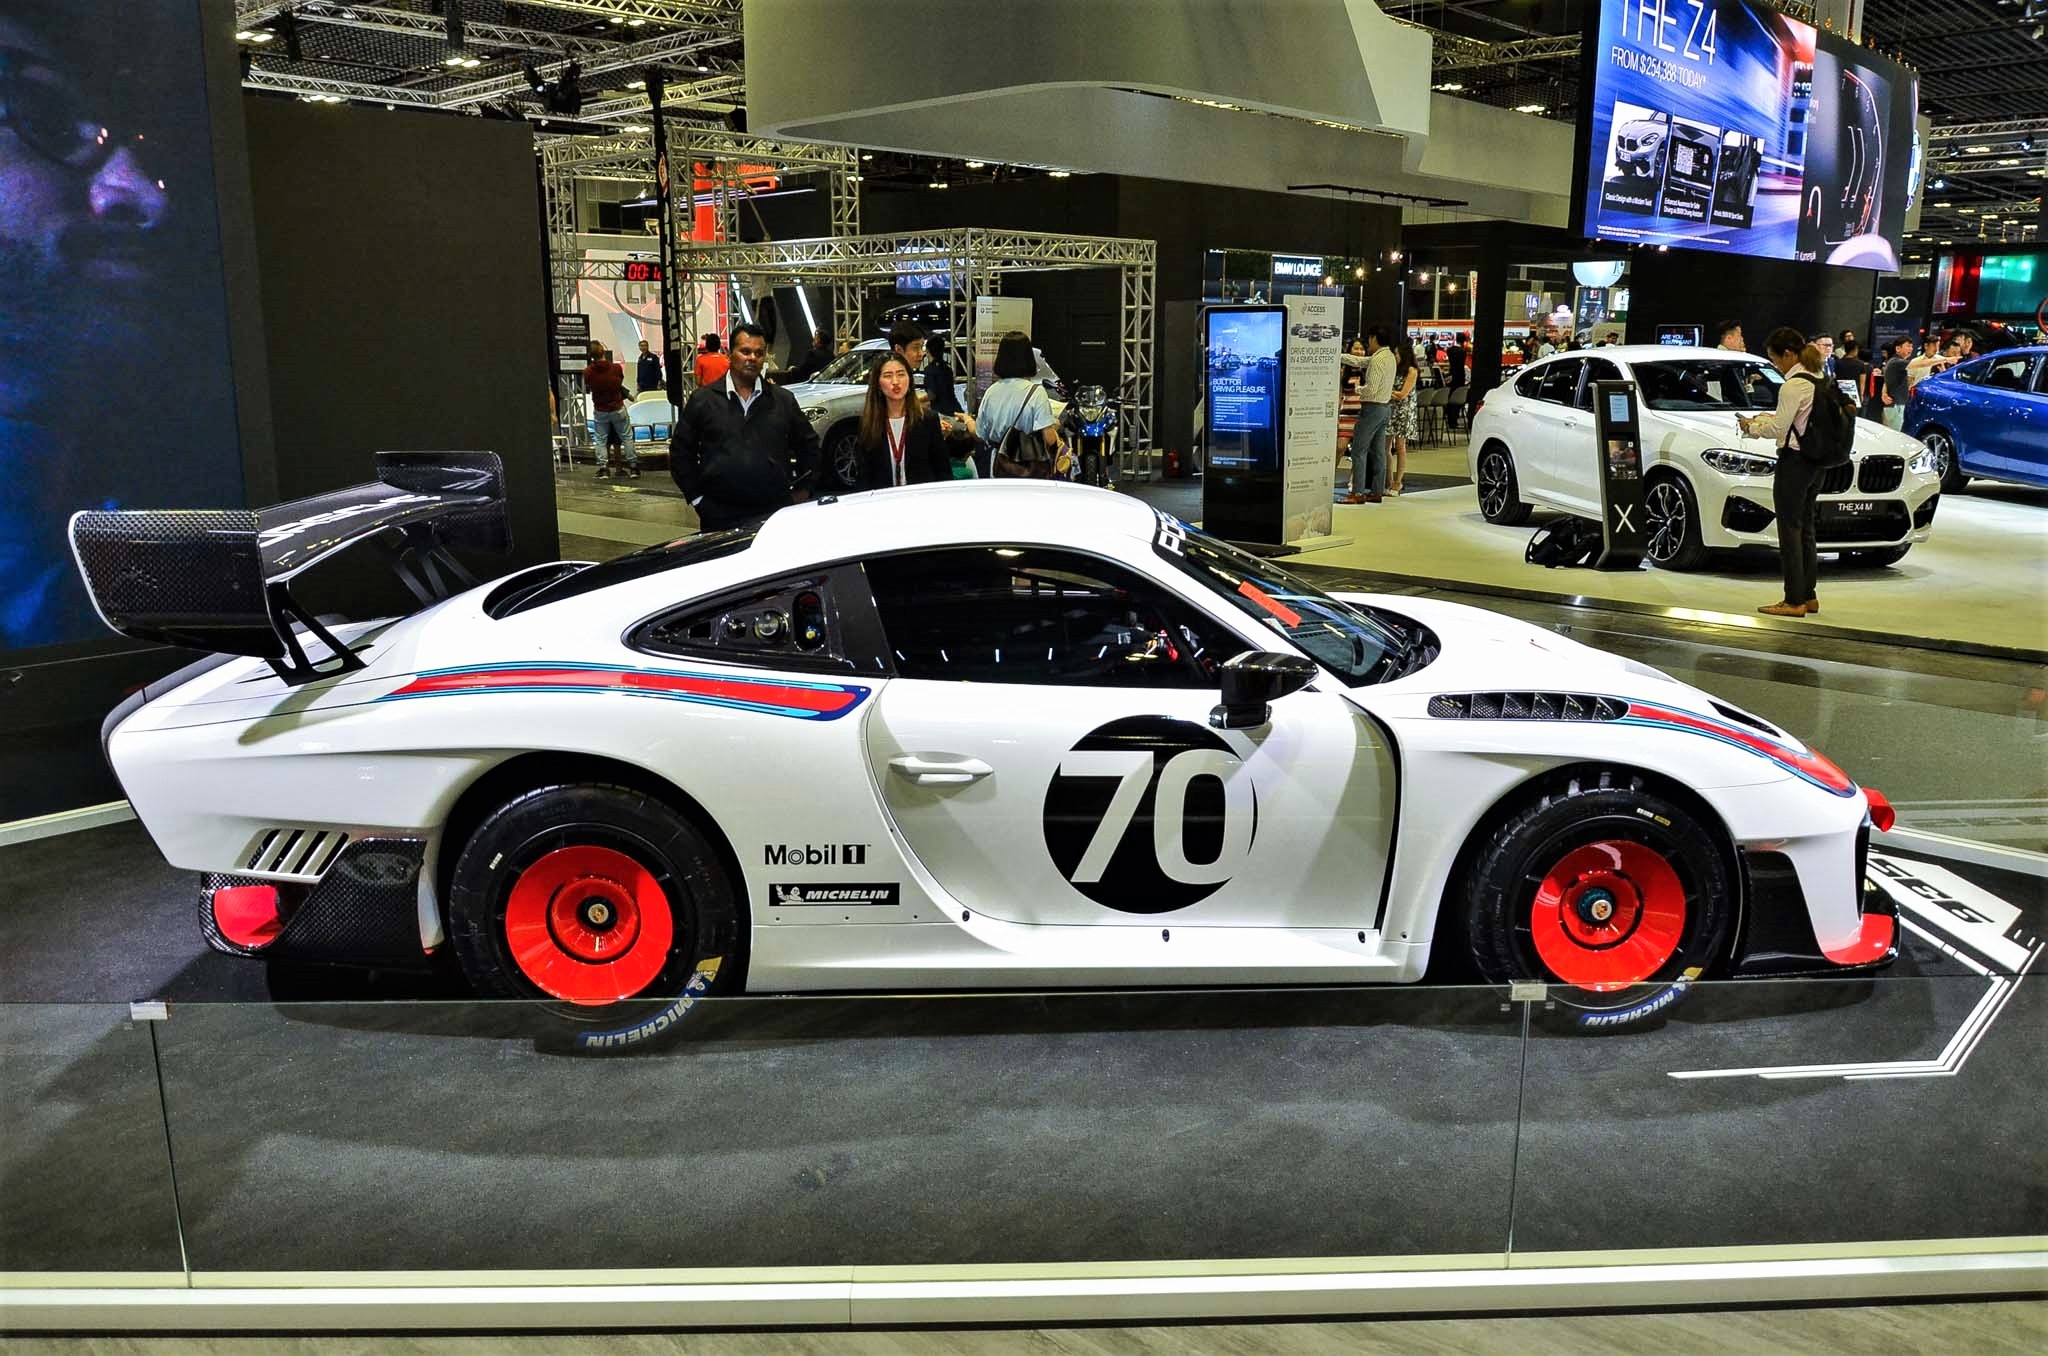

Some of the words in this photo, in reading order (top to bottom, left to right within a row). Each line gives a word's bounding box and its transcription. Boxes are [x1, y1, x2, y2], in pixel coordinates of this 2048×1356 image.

[1621, 0, 1677, 53] THE
[1683, 0, 1717, 65] Z4
[1611, 45, 1639, 71] FROM
[1639, 54, 1677, 82] $254,388
[1274, 261, 1294, 275] BMW
[1293, 263, 1322, 277] LOUNGE
[1307, 305, 1326, 313] ACCESS
[1290, 347, 1305, 355] DRIVE
[1212, 378, 1229, 386] BUILT
[1229, 378, 1242, 386] FOR
[1212, 385, 1235, 393] DRIVING
[1235, 385, 1267, 394] PLEASURE
[1837, 502, 1854, 511] THE
[1854, 502, 1864, 511] X4
[1864, 502, 1873, 511] M
[1614, 503, 1637, 533] X
[1060, 748, 1254, 885] 70
[764, 844, 836, 865] Mobil
[805, 890, 890, 900] MICHELIN
[1585, 990, 1676, 1026] MICHELIN
[585, 994, 695, 1047] MICHELIN
